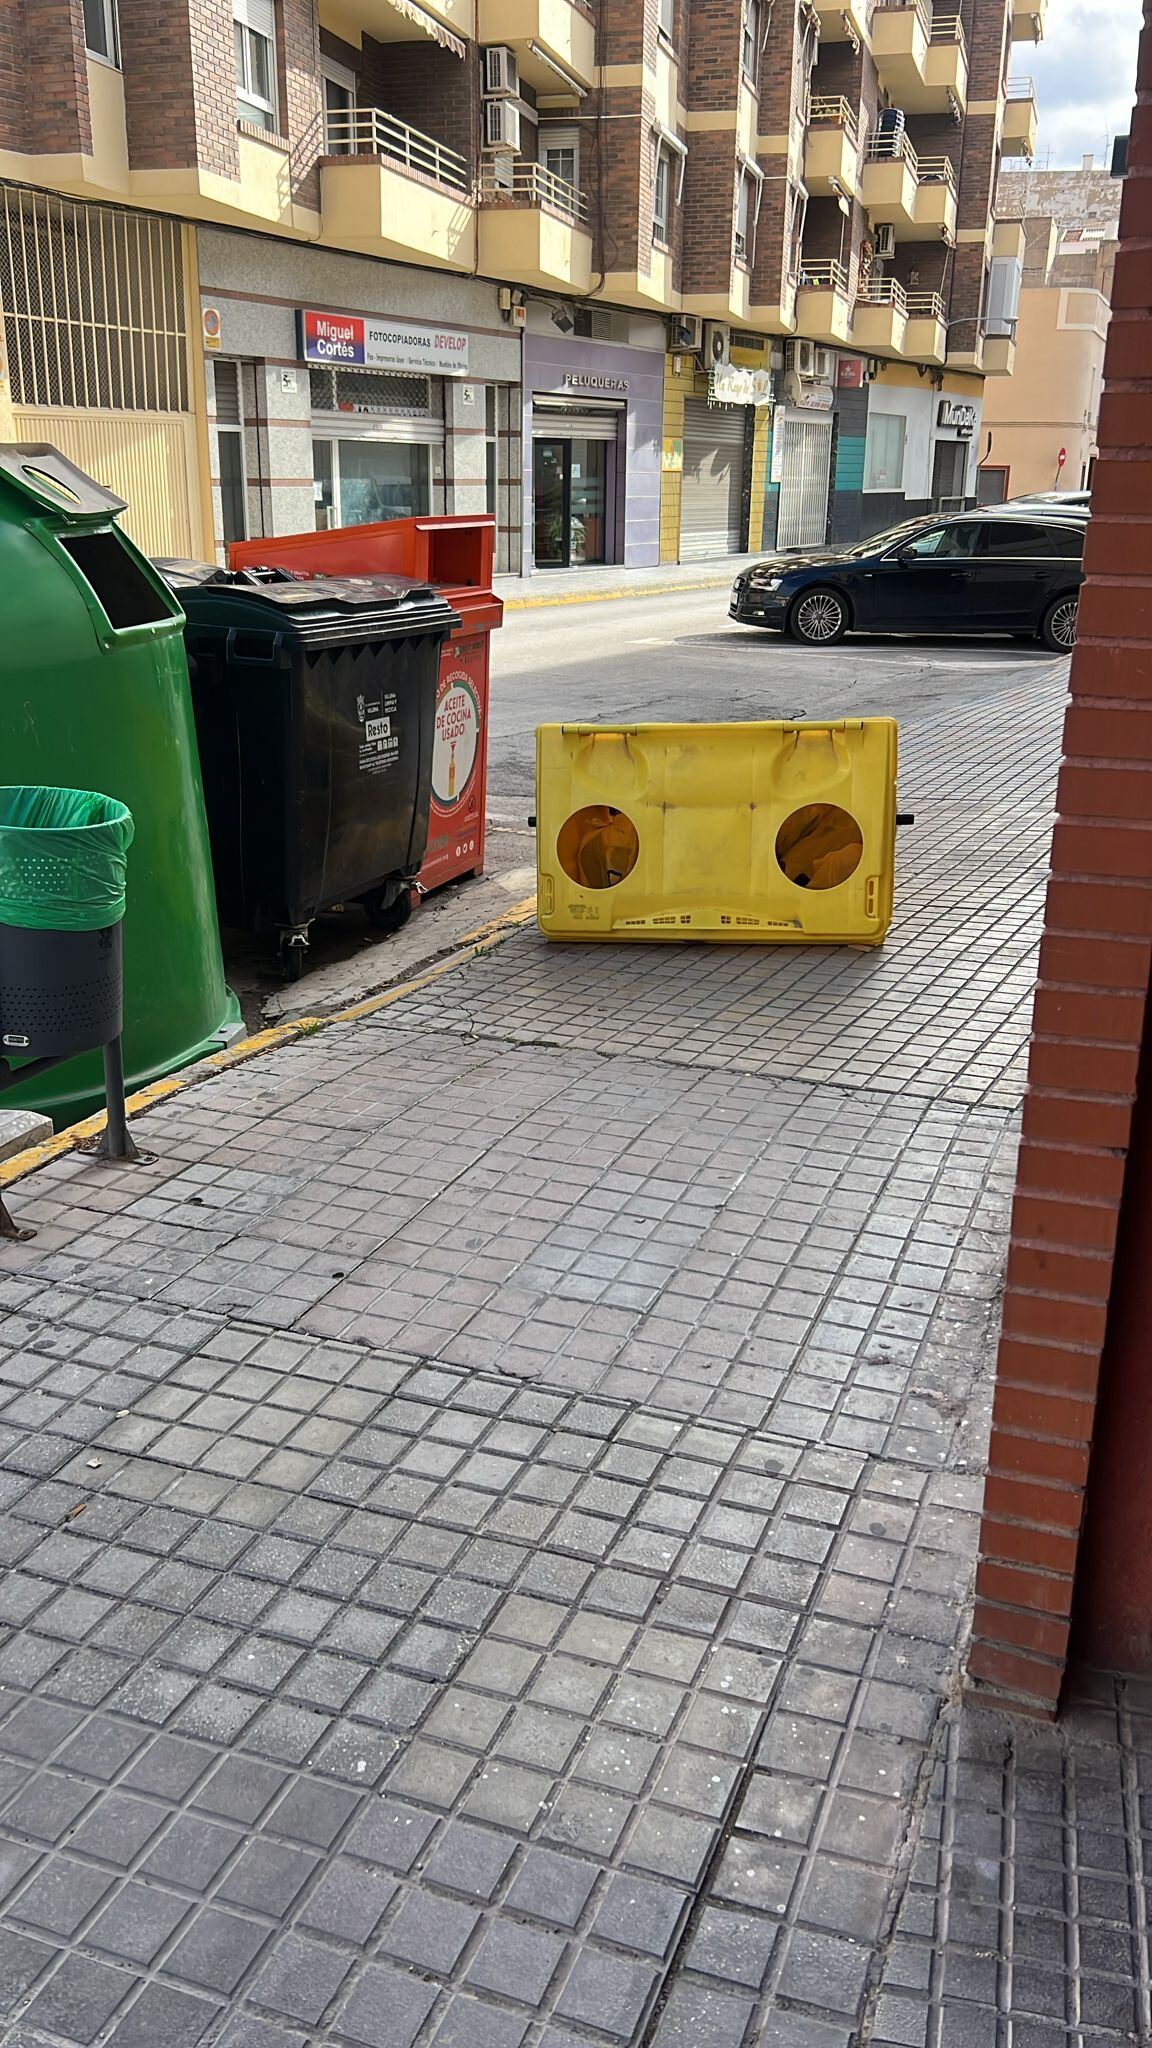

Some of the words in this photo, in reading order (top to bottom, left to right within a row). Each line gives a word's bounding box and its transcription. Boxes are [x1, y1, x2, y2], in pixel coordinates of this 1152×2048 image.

[316, 320, 354, 340] Miguel
[316, 338, 355, 358] Cortés
[369, 331, 431, 348] FOTOCOPIADORAS
[434, 334, 467, 351] DEVELOP
[444, 694, 466, 713] ACEITE
[436, 715, 445, 729] DE
[446, 709, 472, 725] COCINA
[367, 722, 388, 737] Resto
[441, 723, 465, 741] USADO
